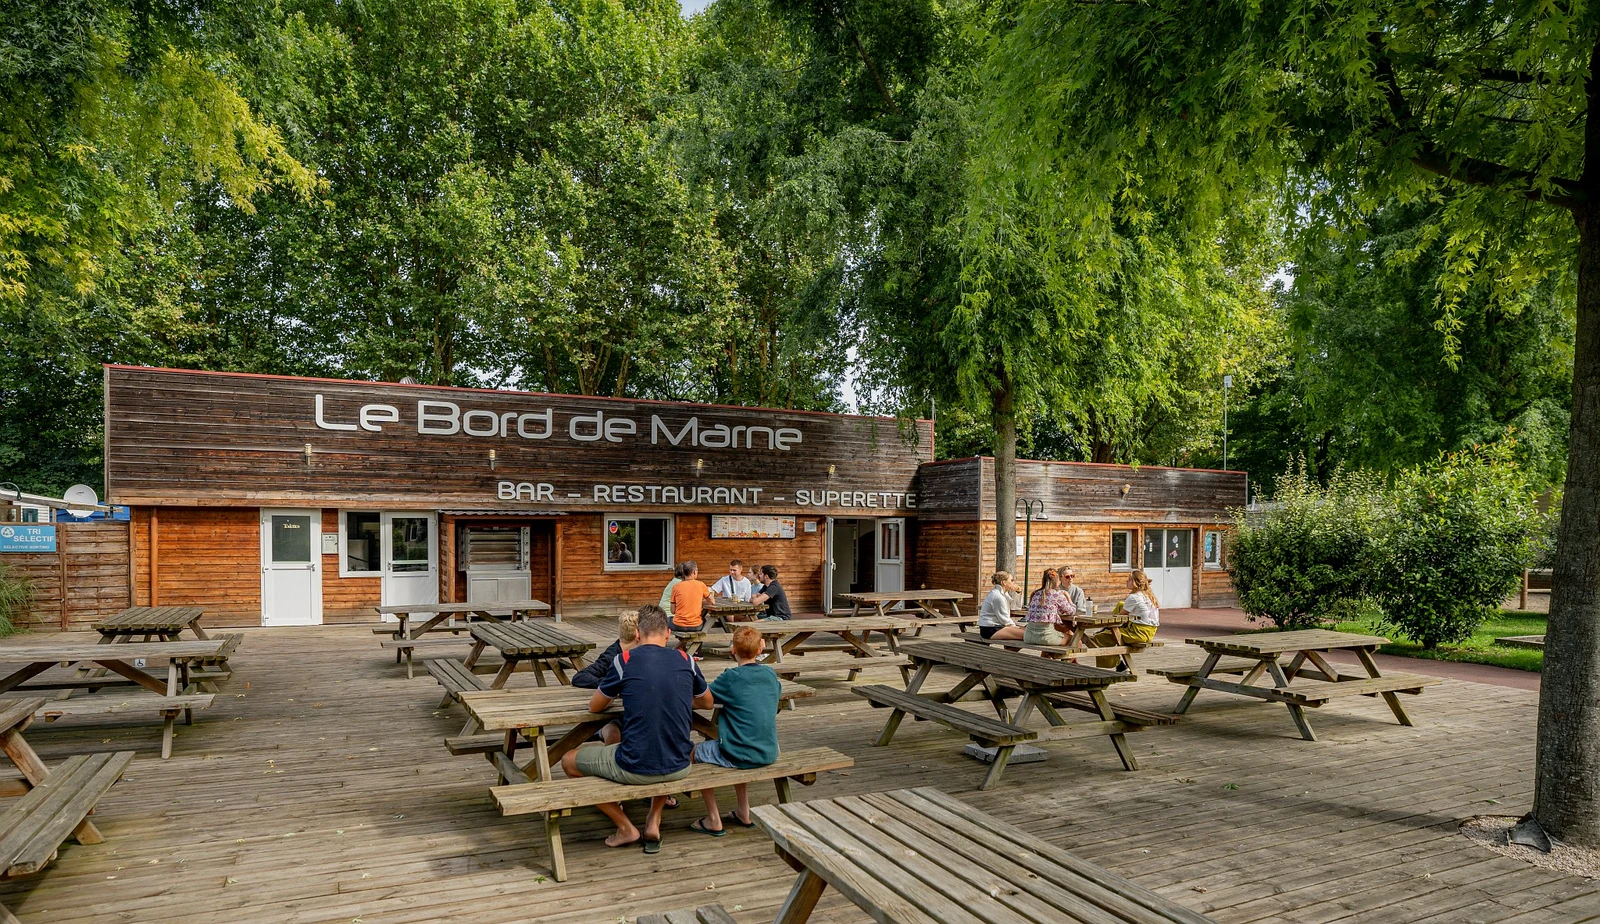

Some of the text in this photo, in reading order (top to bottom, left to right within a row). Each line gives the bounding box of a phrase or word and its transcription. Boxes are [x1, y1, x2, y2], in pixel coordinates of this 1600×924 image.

[315, 394, 803, 450] Le Bord de Marne
[497, 481, 555, 501] BAR
[593, 484, 763, 504] RESTAURANT
[795, 489, 917, 509] SUPERETTE
